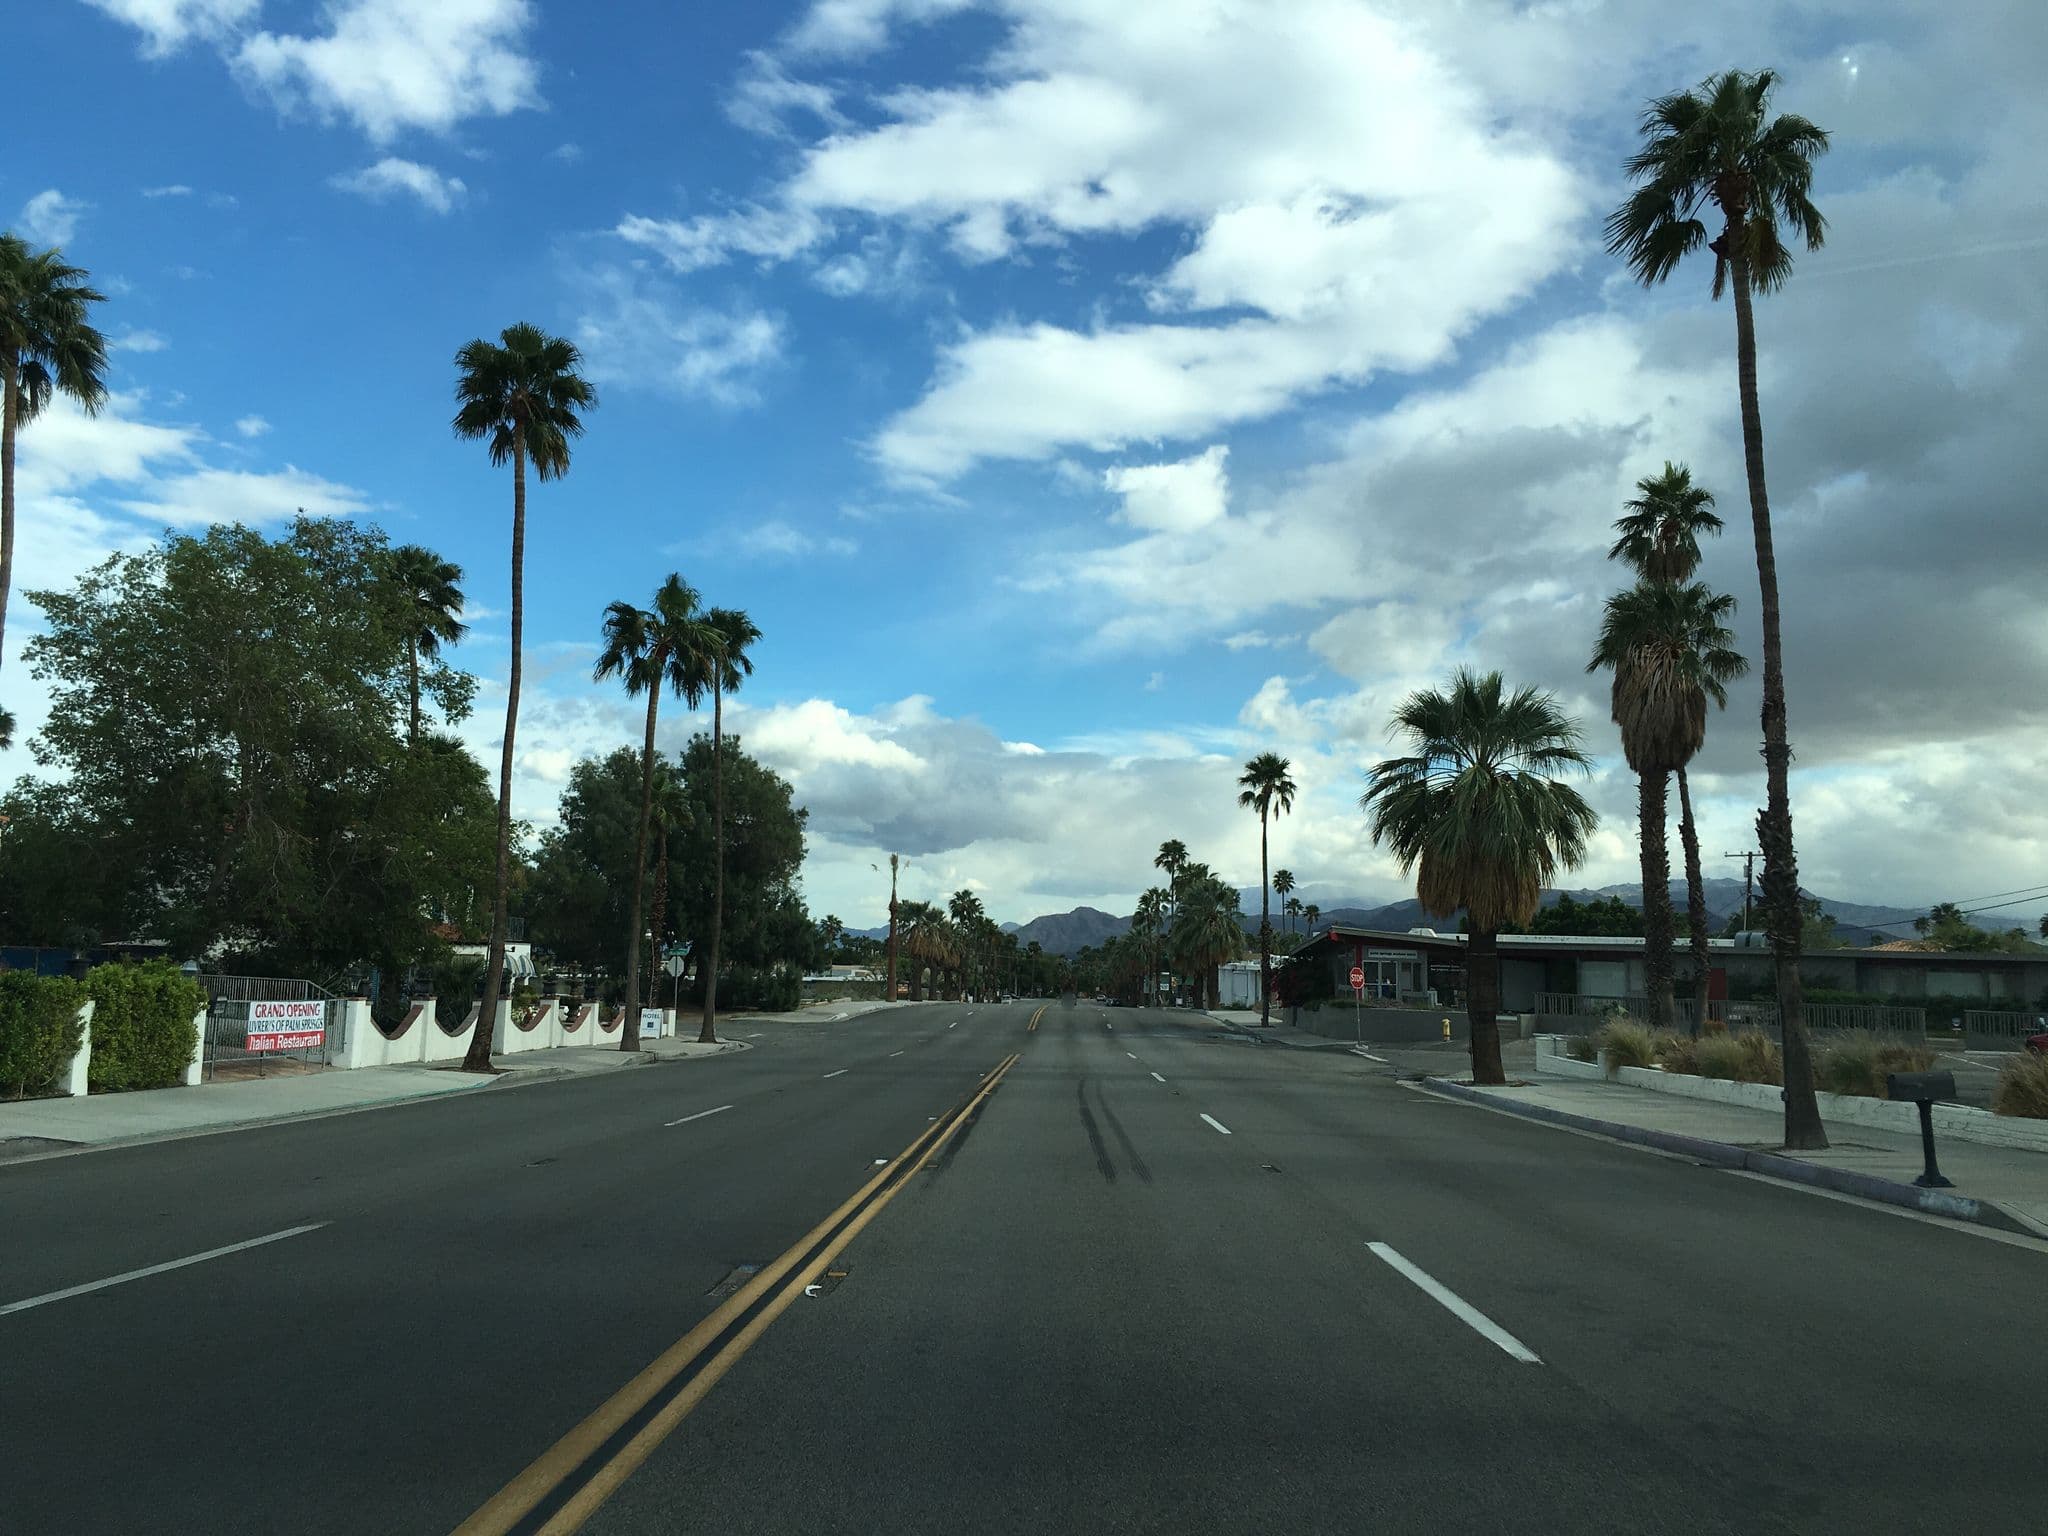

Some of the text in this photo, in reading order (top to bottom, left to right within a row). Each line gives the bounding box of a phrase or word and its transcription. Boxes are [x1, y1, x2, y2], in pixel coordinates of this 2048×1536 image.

[1351, 973, 1363, 982] STOP
[255, 1003, 321, 1018] GRAND OPENING
[276, 1019, 285, 1032] OF
[285, 1019, 301, 1031] PALM
[301, 1018, 323, 1031] SPRINGS
[250, 1033, 321, 1050] Italian Restaurant
